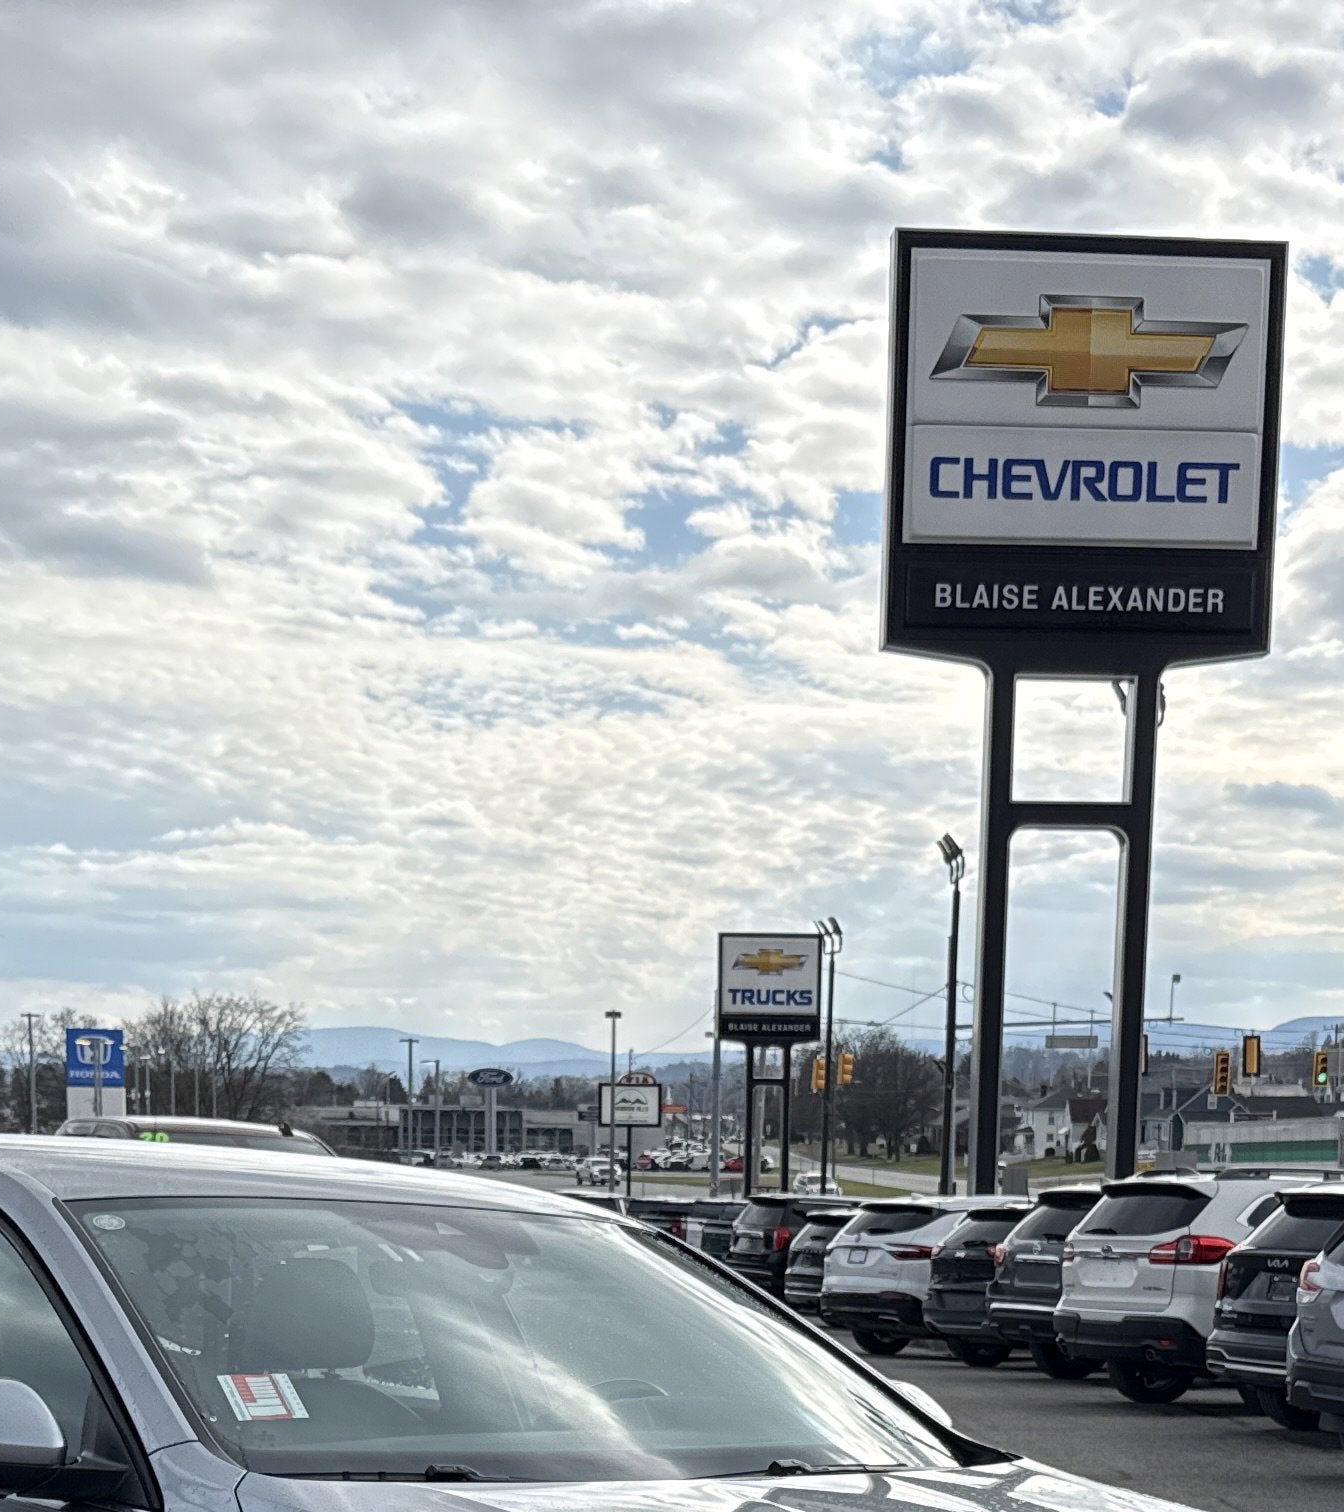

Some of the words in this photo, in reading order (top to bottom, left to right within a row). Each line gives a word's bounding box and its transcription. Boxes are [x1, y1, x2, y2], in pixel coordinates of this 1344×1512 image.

[929, 456, 1241, 504] CHEVROLET
[934, 583, 1040, 611] BLAISE
[1050, 585, 1225, 614] ALEXANDER
[728, 988, 814, 1006] TRUCKS
[728, 1023, 758, 1032] BLAISE
[761, 1023, 812, 1033] ALEXANDER
